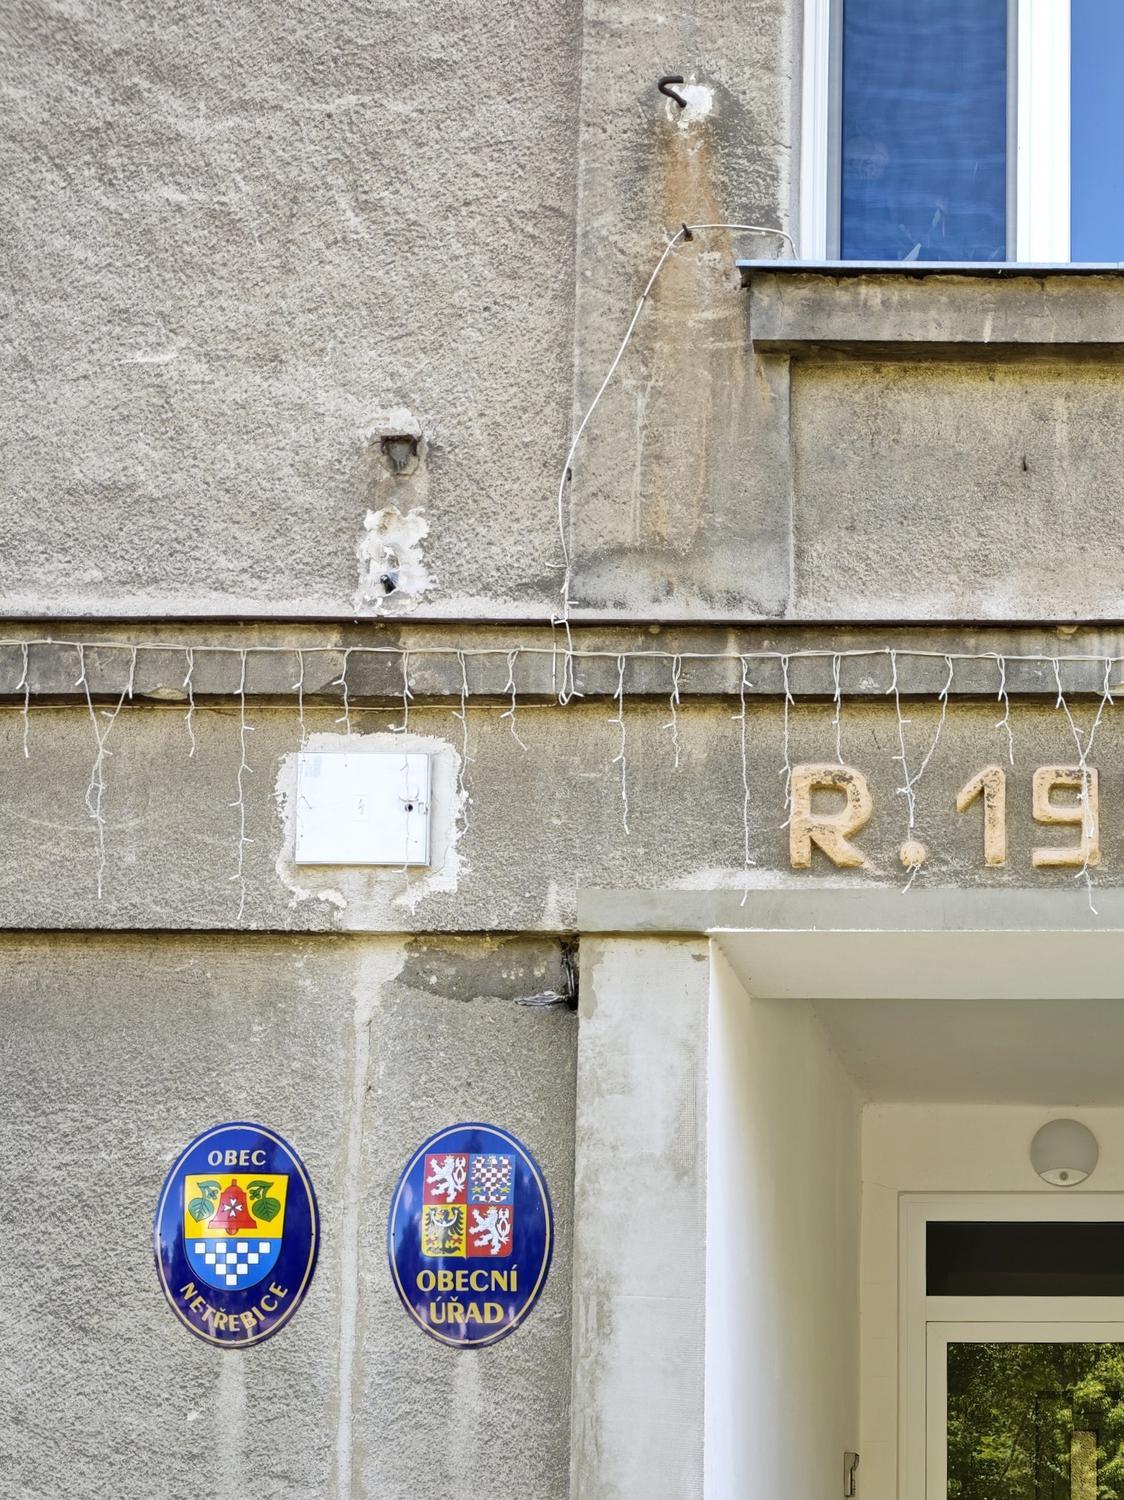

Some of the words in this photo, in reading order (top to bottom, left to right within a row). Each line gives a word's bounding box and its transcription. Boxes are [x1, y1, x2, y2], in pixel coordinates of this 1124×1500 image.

[788, 763, 926, 872] R.
[207, 1149, 267, 1166] OBEC
[416, 1264, 518, 1292] OBECNÍ
[180, 1281, 288, 1332] NETŘEBICE
[429, 1296, 505, 1324] ÚŘAD
